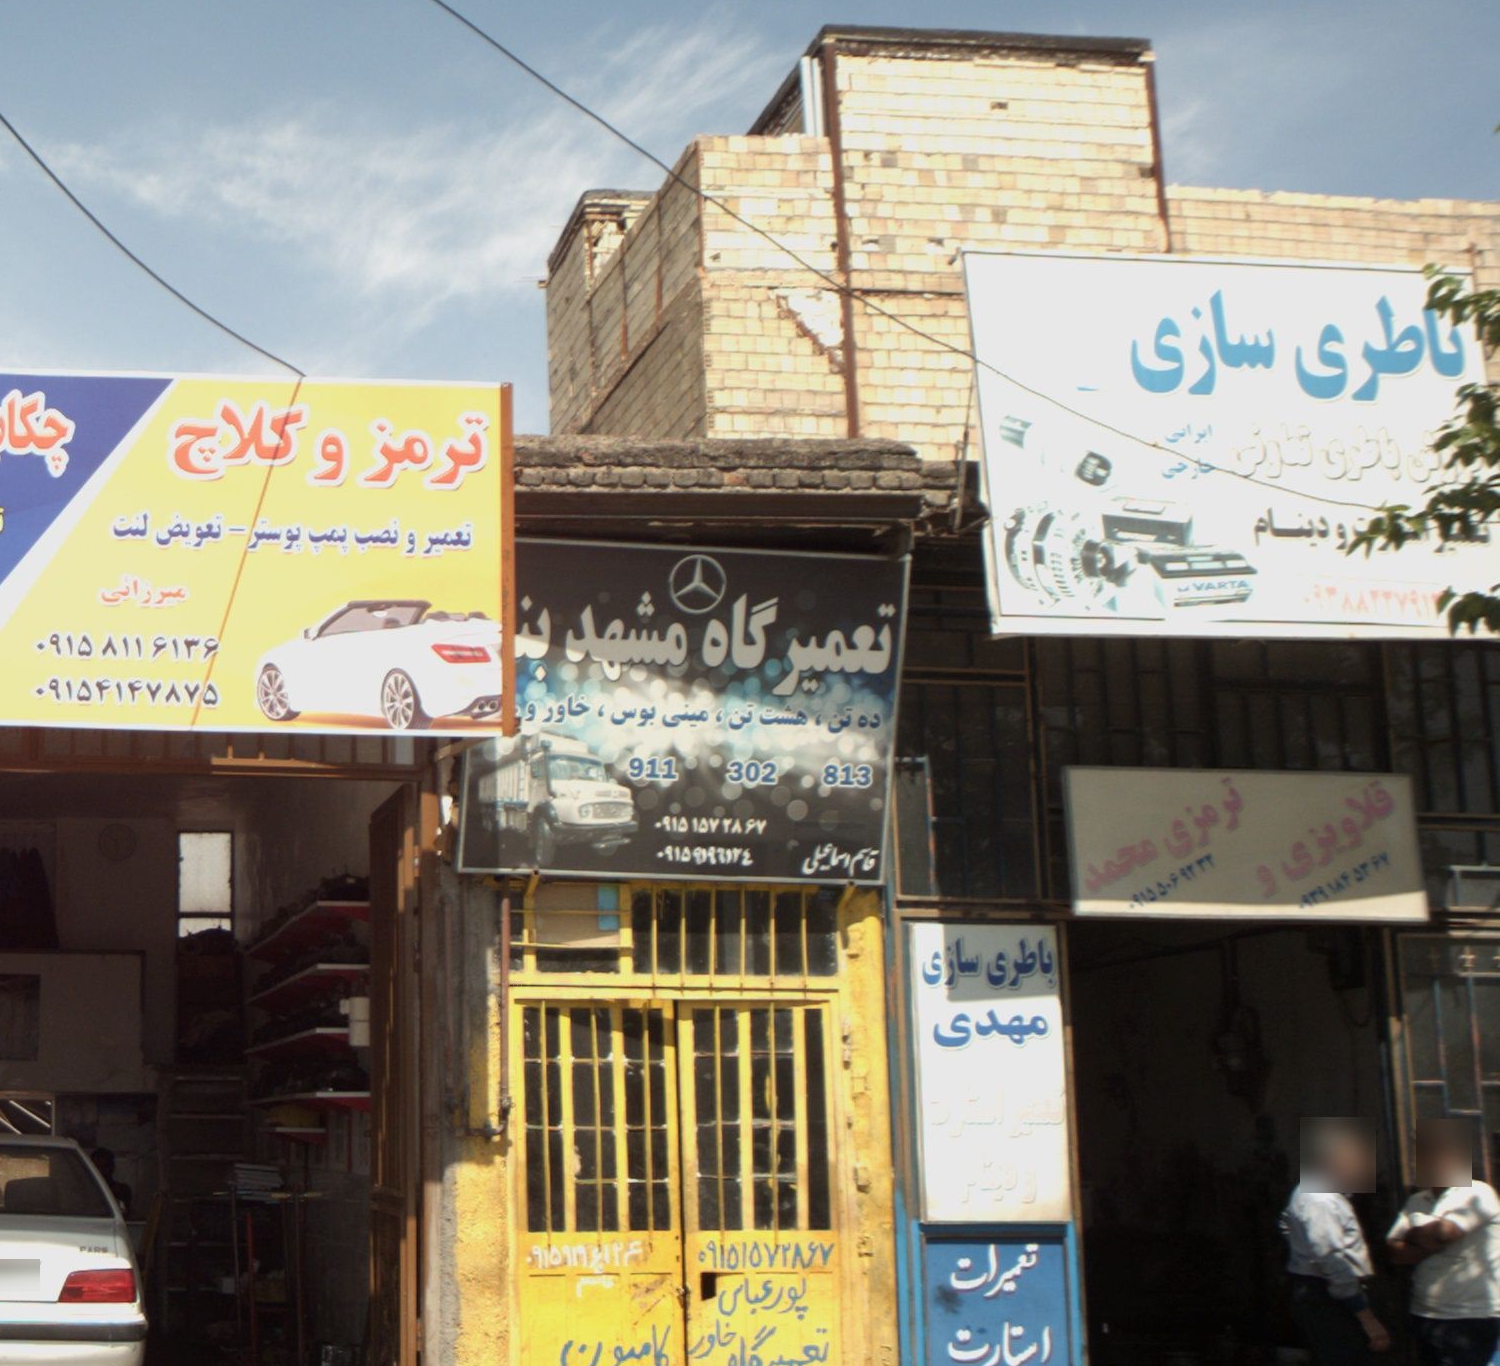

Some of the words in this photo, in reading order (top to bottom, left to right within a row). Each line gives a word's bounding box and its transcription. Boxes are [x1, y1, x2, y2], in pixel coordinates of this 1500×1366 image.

[1130, 288, 1276, 395] سازی
[171, 401, 306, 480] کلاچ
[359, 414, 489, 491] ترمز
[312, 432, 350, 487] و
[111, 511, 150, 541] لنت
[155, 512, 223, 549] تعویض
[247, 519, 302, 553] بوستر
[308, 523, 350, 555] پمپ
[354, 518, 400, 551] نصب
[423, 521, 474, 557] تعمیر
[405, 531, 418, 557] و
[1192, 580, 1248, 591] VARTA
[34, 632, 93, 658] ۰۹۱۵
[101, 634, 144, 658] ۸۱۱
[151, 634, 220, 661] ۶۱۳۶
[514, 595, 551, 682] بن
[565, 590, 688, 682] مشهد
[525, 703, 536, 722] و
[541, 695, 590, 723] خاور
[662, 705, 710, 728] مینی
[856, 713, 882, 729] ده
[628, 756, 679, 781] 911
[726, 760, 779, 784] 302
[823, 763, 874, 787] 813
[654, 815, 689, 833] ۰۹۱۵
[921, 936, 981, 988] سازی
[986, 937, 1059, 990] باطری
[931, 1007, 1050, 1049] مهدی
[950, 1243, 1040, 1300] تعمیرات
